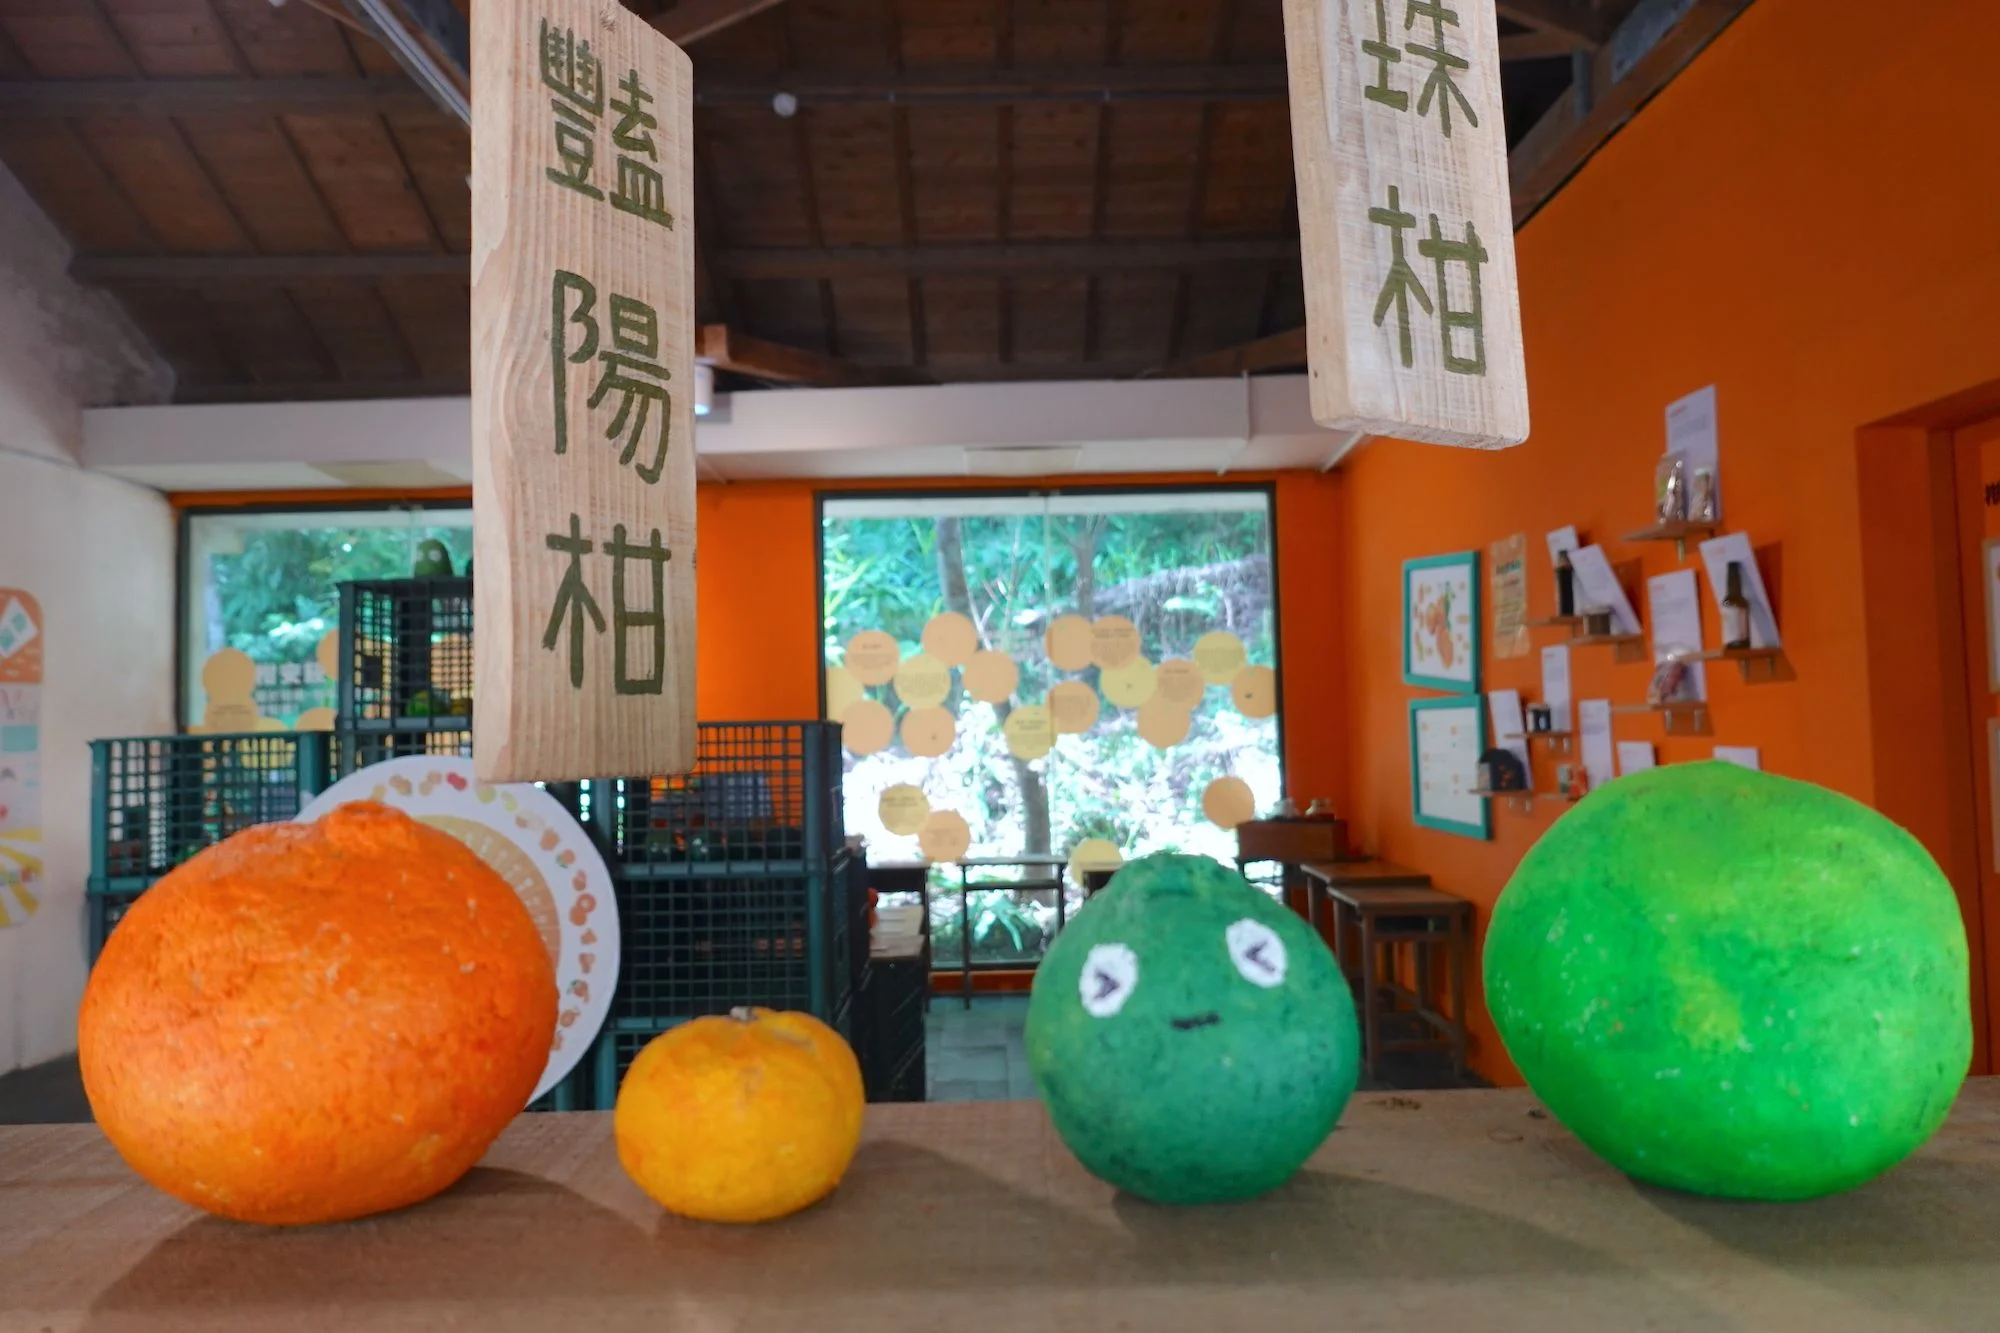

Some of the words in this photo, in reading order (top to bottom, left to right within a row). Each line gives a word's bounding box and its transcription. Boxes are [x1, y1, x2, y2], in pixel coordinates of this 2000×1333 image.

[540, 17, 674, 694] 豔陽柑
[1361, 0, 1488, 376] 珠柑
